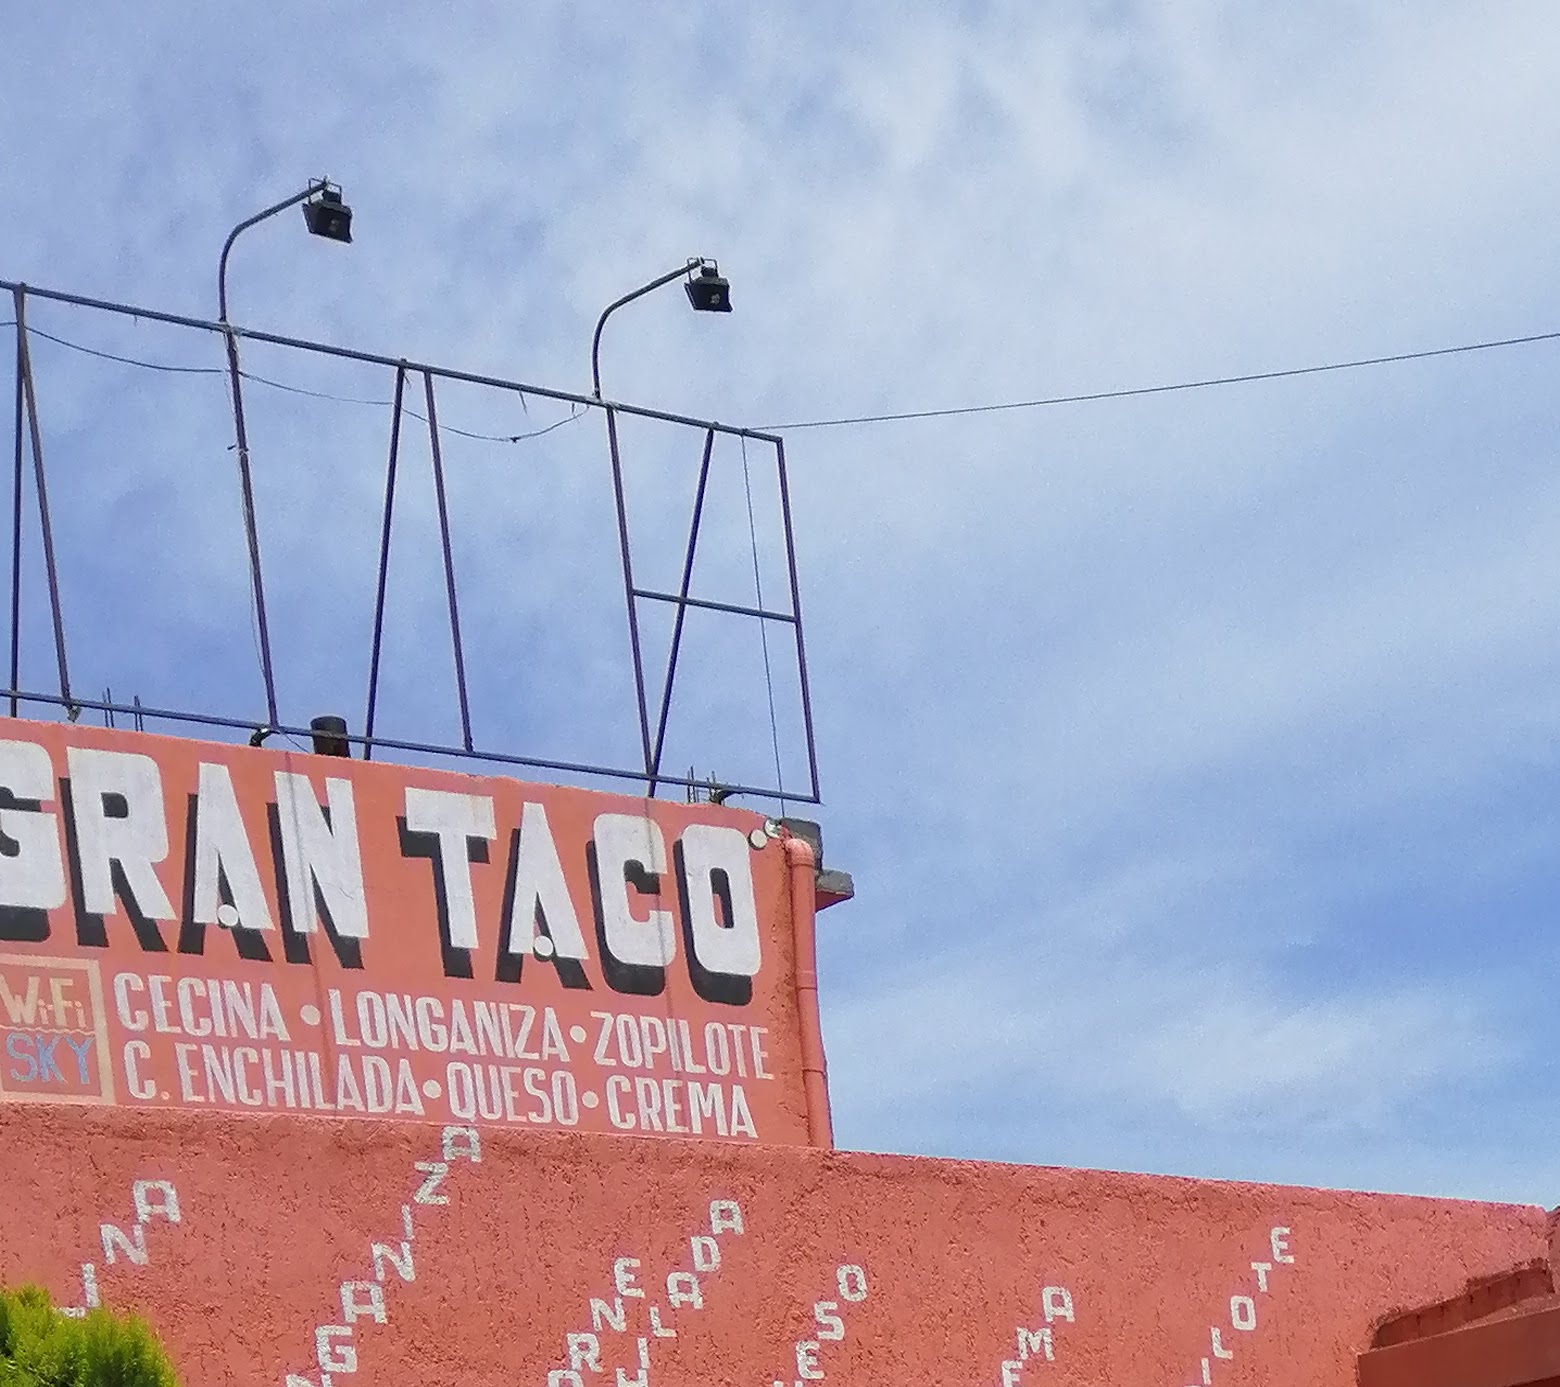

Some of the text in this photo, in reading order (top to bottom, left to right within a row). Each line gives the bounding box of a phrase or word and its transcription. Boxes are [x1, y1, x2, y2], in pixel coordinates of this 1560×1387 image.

[0, 738, 762, 982] GRAN TACO
[6, 1031, 95, 1085] SKY
[113, 972, 774, 1080] CECINA LONGANIZA ZOPILOTE
[123, 1040, 758, 1138] C. ENCHILADA QUESO CREMA
